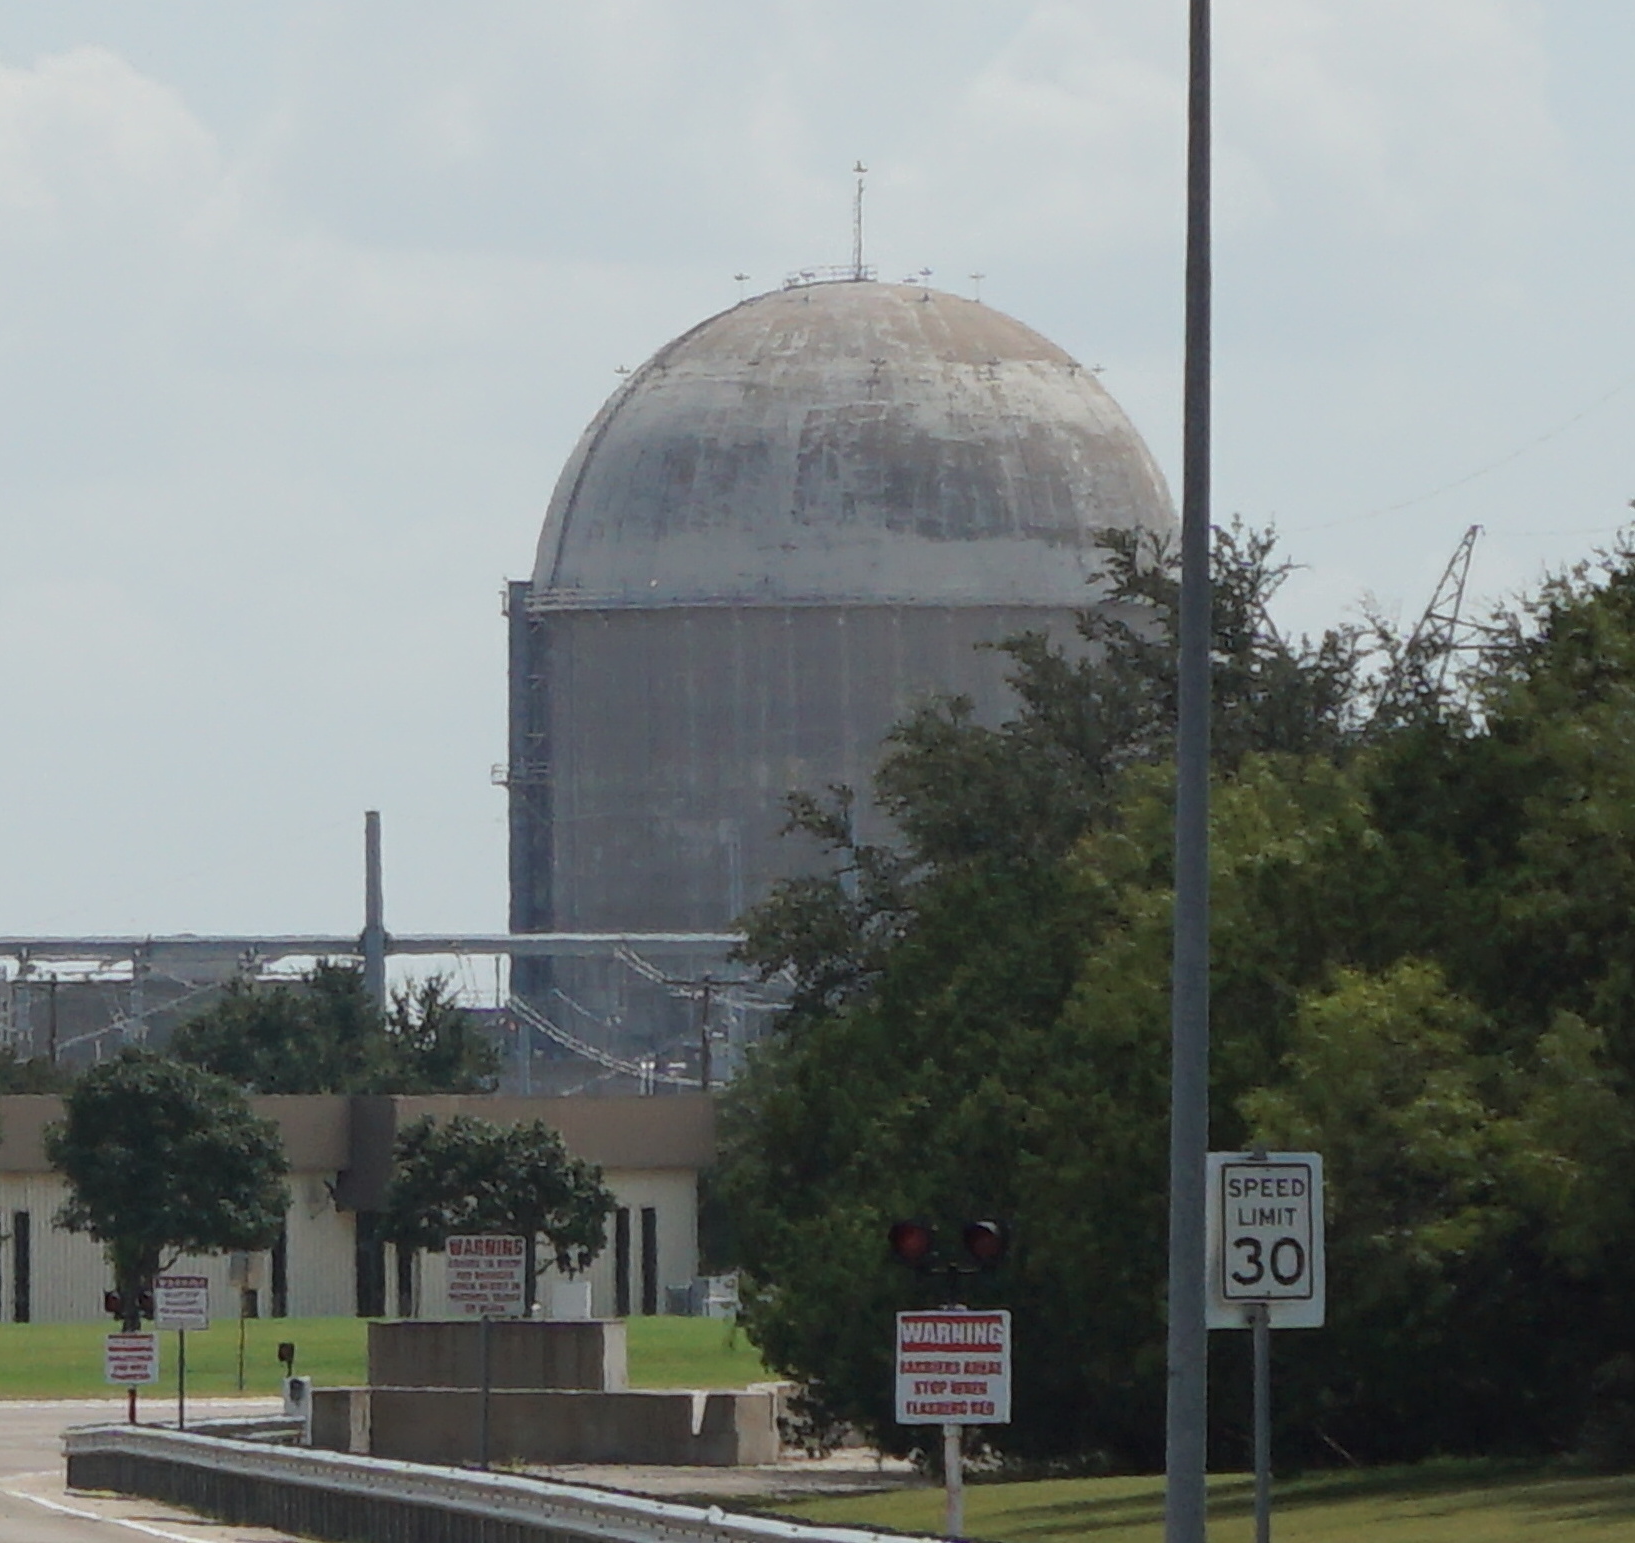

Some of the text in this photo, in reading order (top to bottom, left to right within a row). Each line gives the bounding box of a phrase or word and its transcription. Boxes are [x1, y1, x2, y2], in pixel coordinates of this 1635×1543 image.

[1228, 1178, 1305, 1198] SPEED
[1238, 1207, 1297, 1227] LIMIT
[449, 1238, 523, 1256] WARNING
[1231, 1236, 1305, 1286] 30
[901, 1321, 1004, 1345] WARNING
[914, 1381, 946, 1395] STOP
